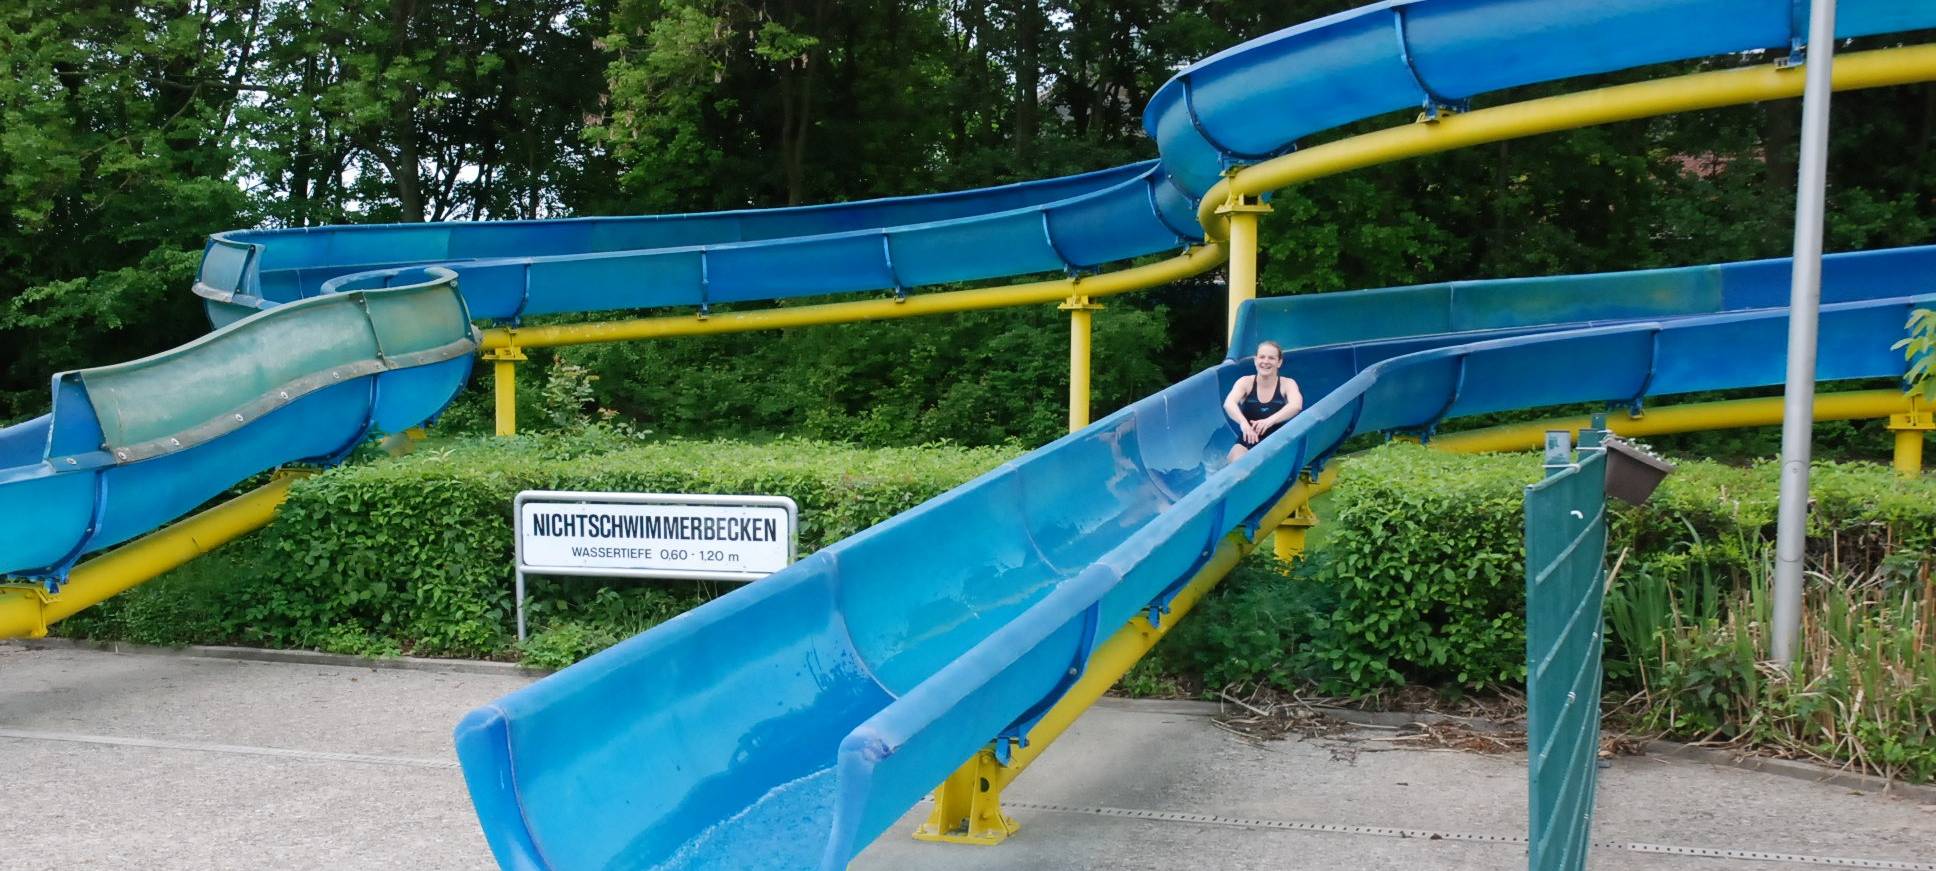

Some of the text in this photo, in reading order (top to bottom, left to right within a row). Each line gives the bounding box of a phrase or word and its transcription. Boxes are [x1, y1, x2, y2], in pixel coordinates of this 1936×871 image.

[533, 513, 777, 541] NICHTSCHWIMMERBECKEN
[571, 547, 652, 559] WASSERTIEFE
[728, 552, 740, 562] m
